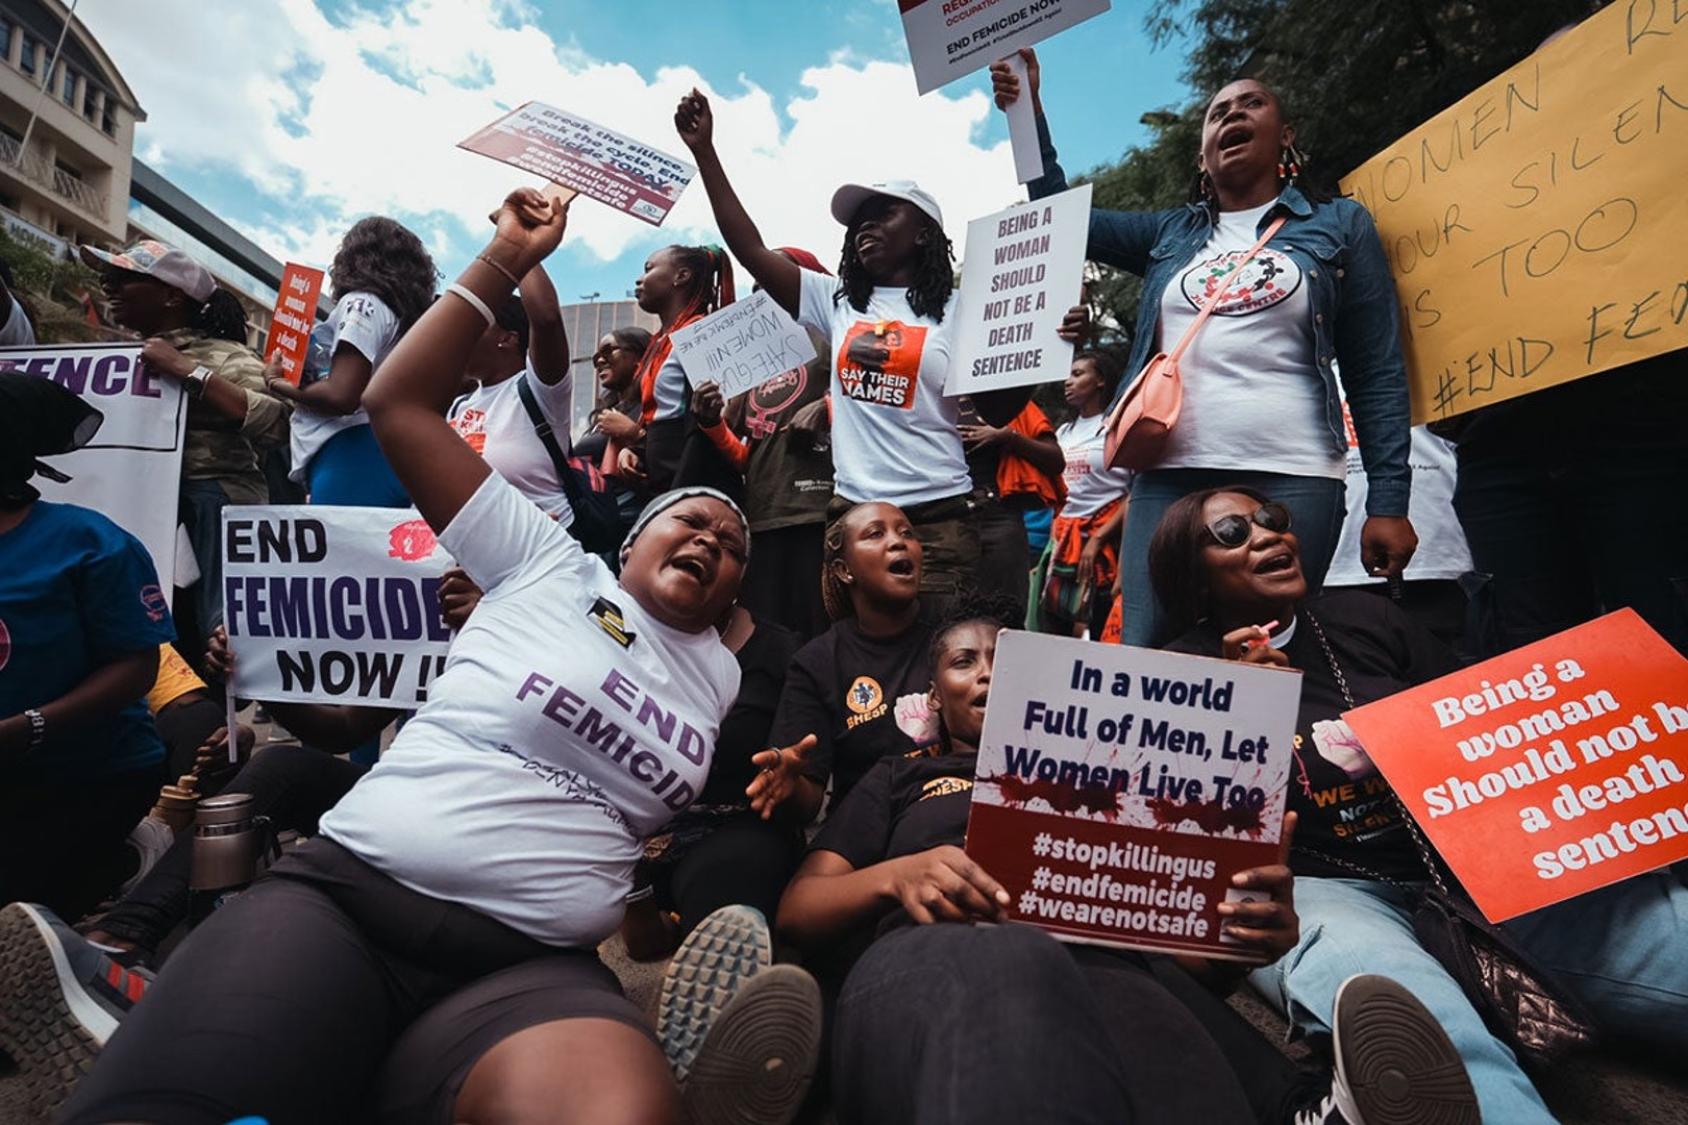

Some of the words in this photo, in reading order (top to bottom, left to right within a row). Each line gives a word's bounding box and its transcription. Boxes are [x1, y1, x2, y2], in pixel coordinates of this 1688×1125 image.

[946, 0, 1001, 26] OCCUPATIO
[946, 36, 970, 54] END
[972, 7, 1028, 42] FEMICIDE
[518, 112, 569, 136] break
[572, 132, 603, 149] the
[605, 145, 654, 171] cycle.
[659, 167, 691, 185] End
[525, 124, 602, 159] femicide
[541, 109, 591, 133] Break
[595, 130, 626, 146] the
[508, 156, 627, 210] #wearenotsafe
[520, 153, 629, 201] #endfemicide
[525, 147, 638, 197] #stopkillingus
[998, 210, 1038, 239] BEING
[1042, 206, 1052, 226] A
[994, 233, 1049, 266] WOMAN
[1472, 198, 1638, 298] TOO
[991, 263, 1046, 293] SHOULD
[1238, 288, 1287, 310] CENTRE
[983, 299, 1011, 321] NOT
[1013, 294, 1032, 315] BE
[1035, 291, 1045, 311] A
[988, 322, 1033, 348] DEATH
[841, 368, 866, 380] SAY
[870, 371, 909, 389] THEIR
[972, 349, 1042, 377] SENTENCE
[1432, 337, 1554, 419] #END
[226, 519, 328, 563] END
[226, 576, 450, 642] FEMICIDE
[276, 650, 404, 699] NOW
[1070, 660, 1101, 692] In
[1111, 673, 1131, 697] a
[1141, 676, 1234, 712] world
[1431, 663, 1556, 728] Being
[1555, 658, 1585, 683] a
[600, 668, 706, 767] END
[846, 703, 888, 729] SHESP
[1023, 700, 1089, 739] Full
[1097, 714, 1134, 745] of
[1138, 719, 1212, 761] Men,
[1221, 730, 1269, 764] Let
[1457, 689, 1620, 762] woman
[1004, 745, 1131, 793] Women
[1138, 761, 1203, 801] Live
[1212, 776, 1266, 811] Too
[1423, 739, 1577, 819] Should
[1577, 714, 1659, 765] not
[1651, 698, 1688, 735] b
[1313, 783, 1356, 808] WE
[1519, 805, 1551, 834] a
[1552, 755, 1685, 821] death
[1032, 832, 1217, 883] #stopkillingus
[1533, 802, 1688, 880] senten
[1031, 866, 1207, 912] #endfemicide
[1018, 890, 1209, 938] #wearenotsafe
